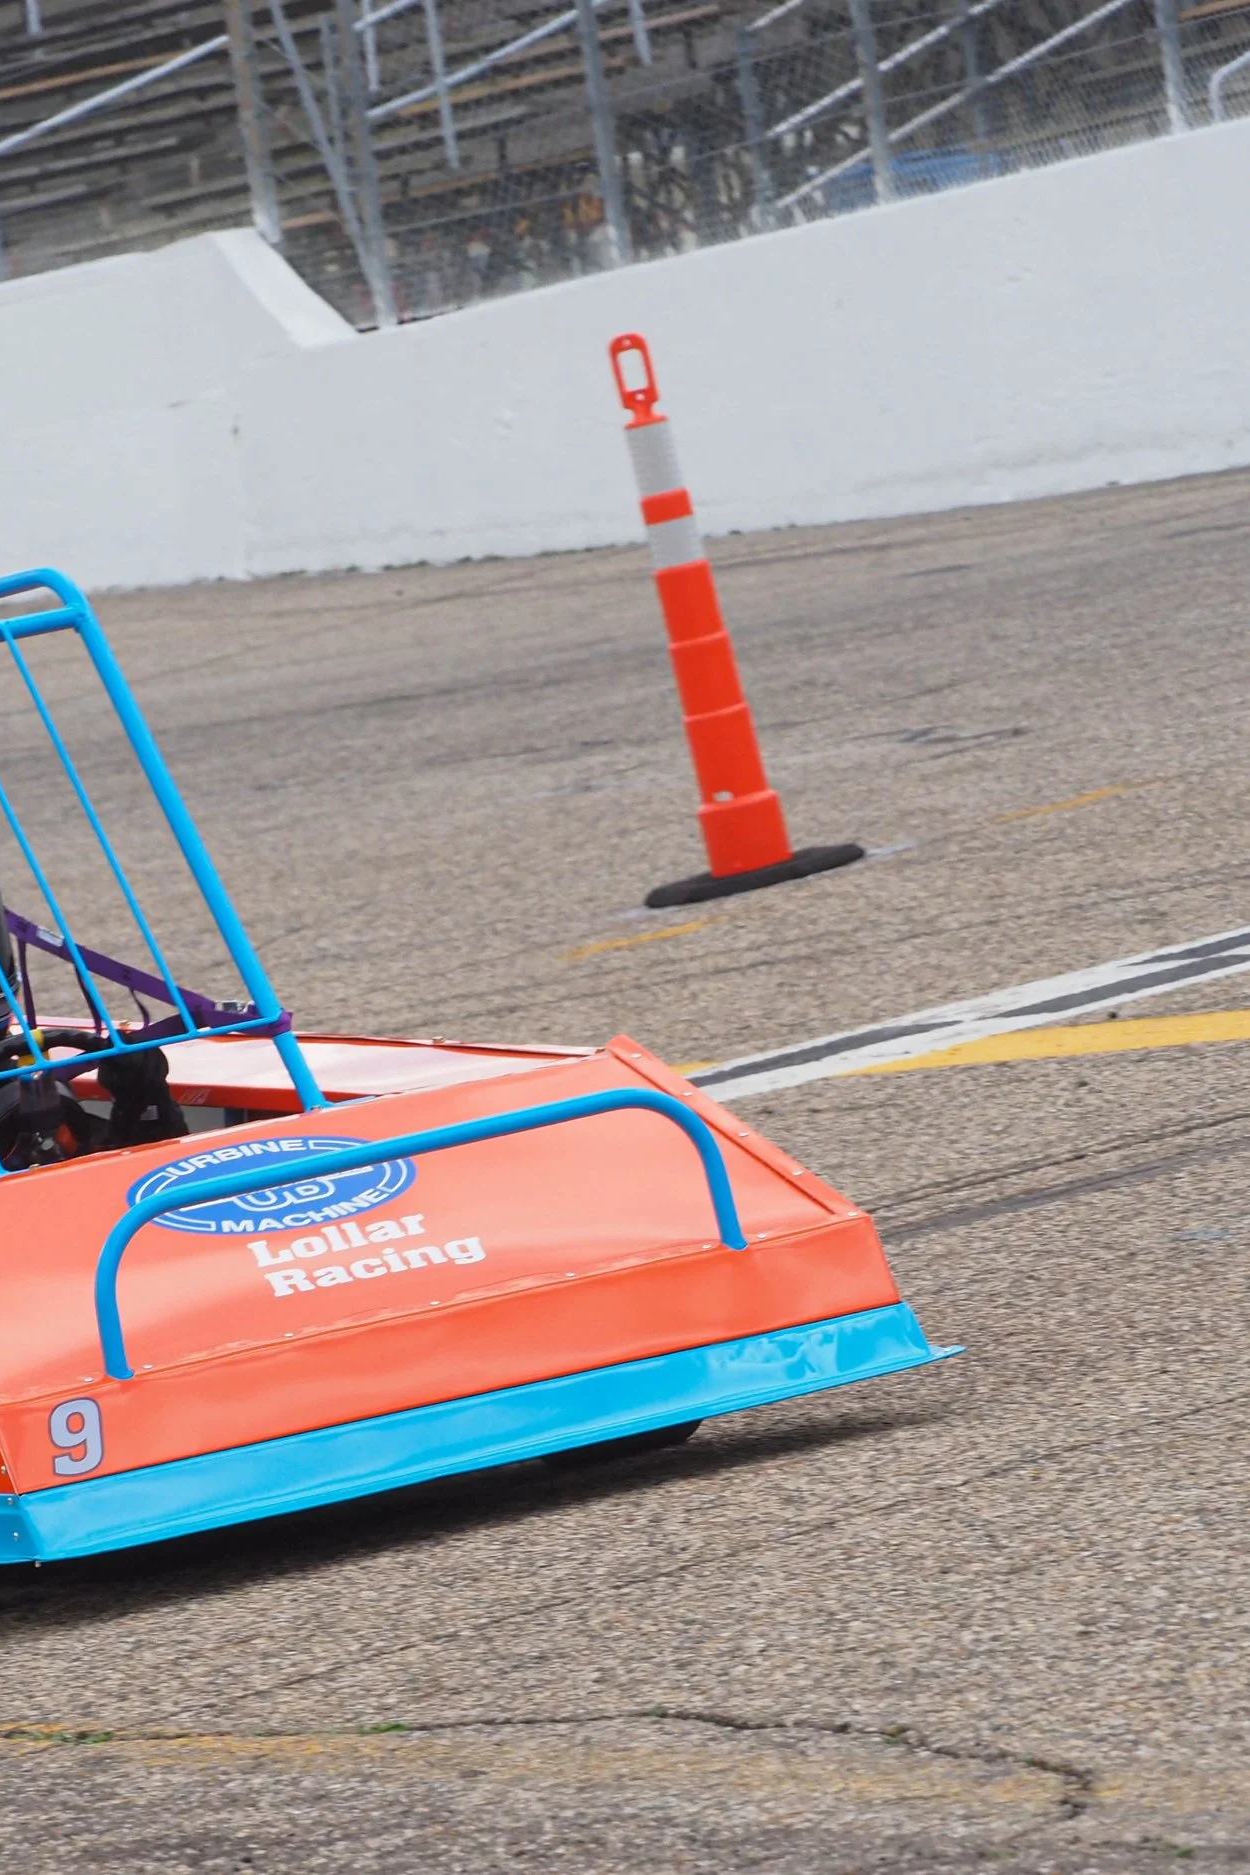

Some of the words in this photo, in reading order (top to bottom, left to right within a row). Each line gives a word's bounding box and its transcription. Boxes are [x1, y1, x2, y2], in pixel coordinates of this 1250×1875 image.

[166, 1139, 307, 1176] URBINE
[222, 1188, 387, 1233] MACHINE
[247, 1214, 427, 1268] Lollar
[263, 1237, 487, 1297] Racing
[49, 1397, 104, 1477] 9
